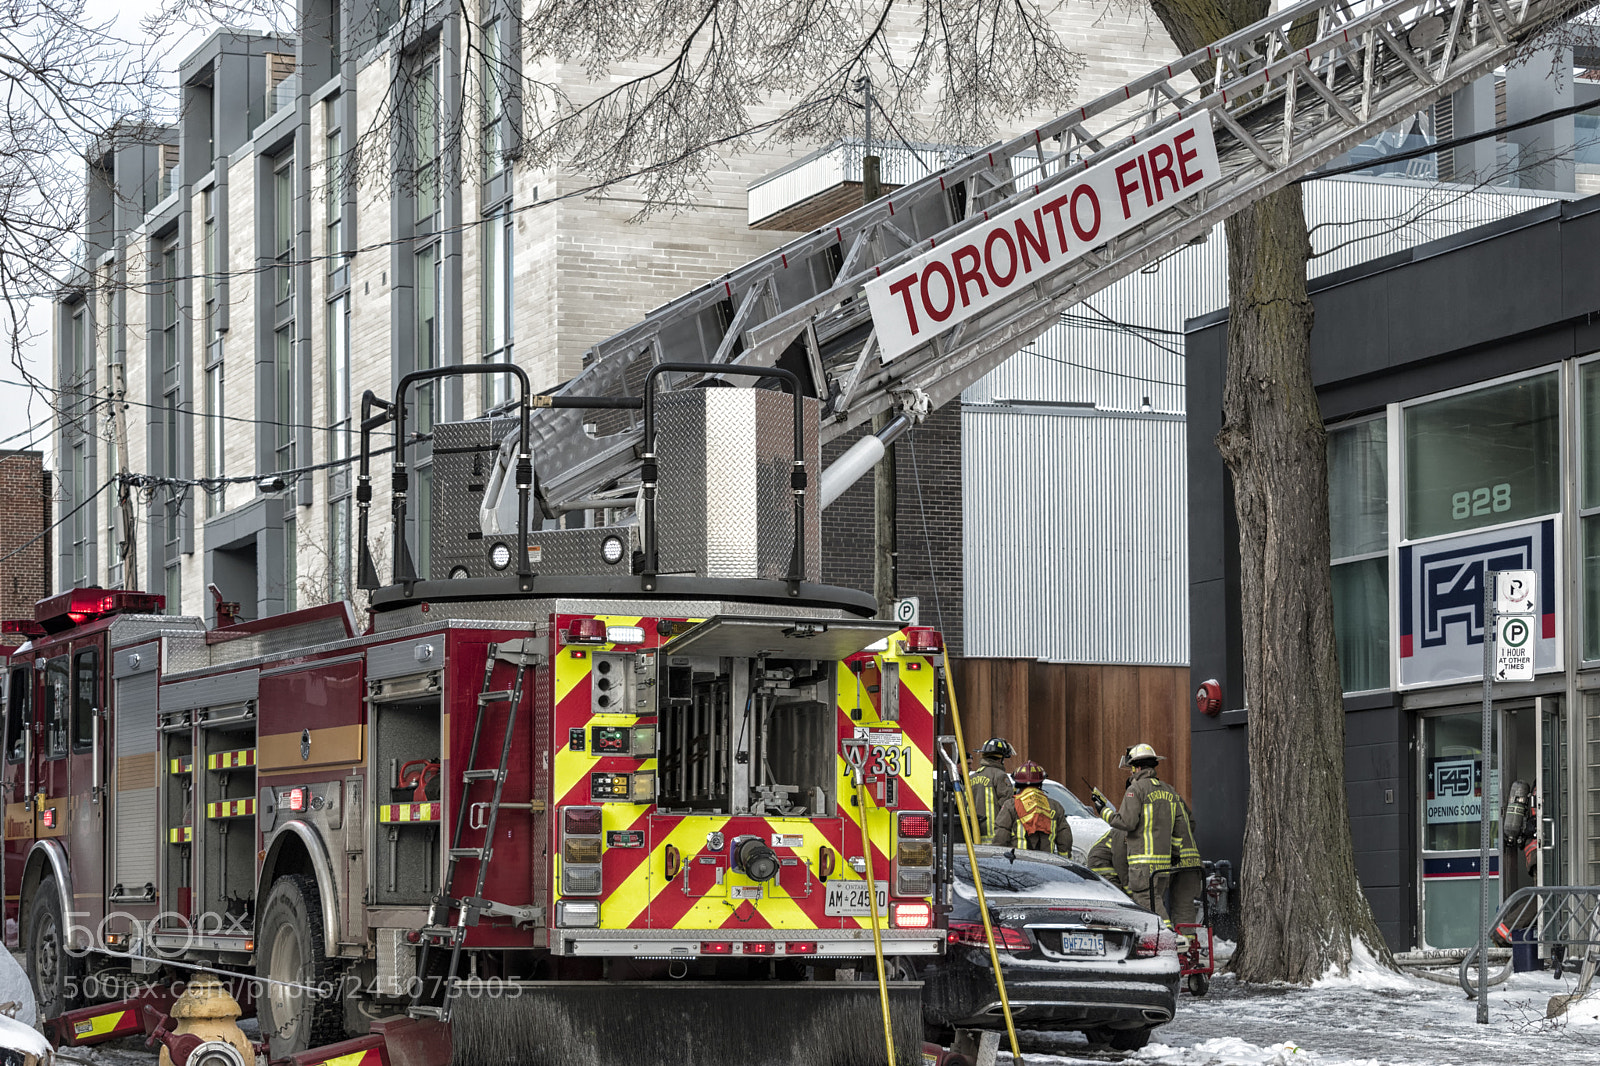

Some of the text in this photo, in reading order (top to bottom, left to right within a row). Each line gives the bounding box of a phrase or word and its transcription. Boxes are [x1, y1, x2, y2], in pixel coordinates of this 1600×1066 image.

[889, 127, 1204, 336] TORONTO FIRE
[1452, 483, 1512, 520] 828
[1511, 625, 1523, 641] P
[1507, 648, 1526, 657] HOUR
[870, 745, 912, 777] 331
[1438, 765, 1472, 796] F45
[1146, 790, 1173, 803] TORONTO
[1428, 804, 1481, 818] OPENING SOON
[828, 890, 886, 907] AM 2450
